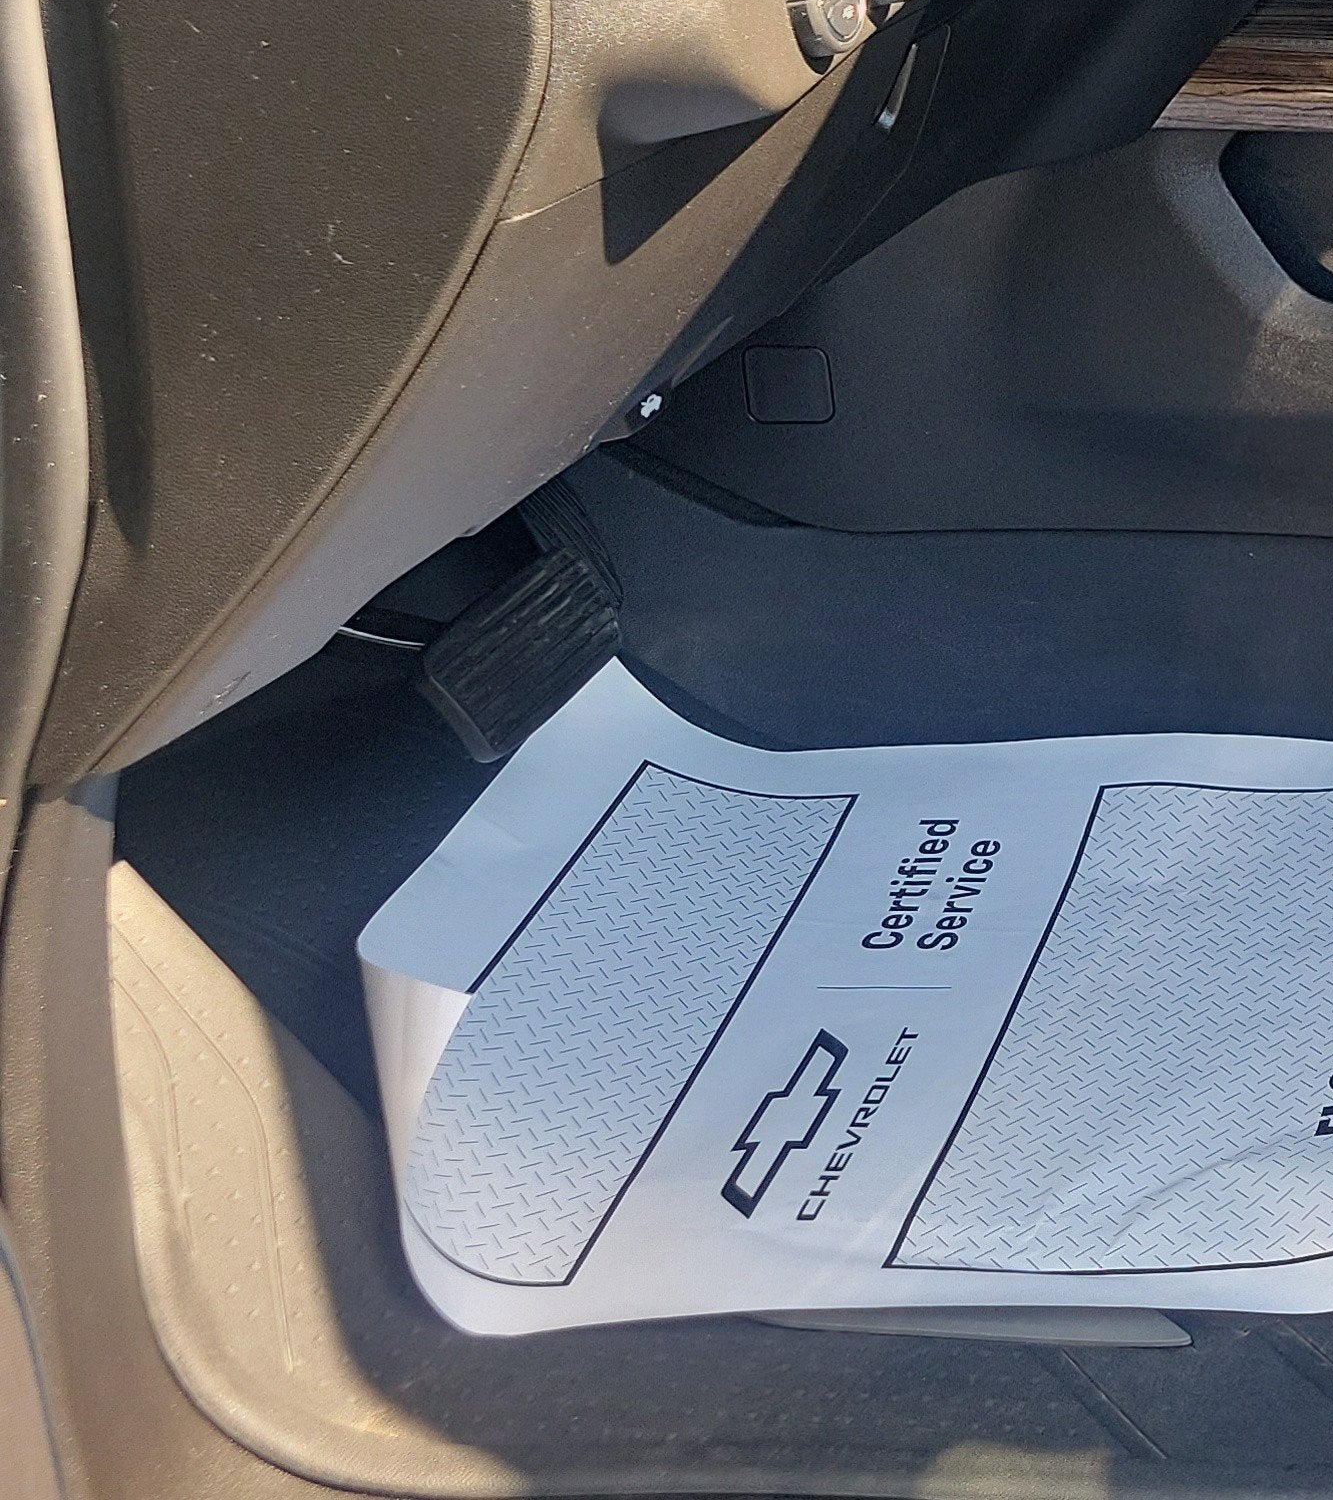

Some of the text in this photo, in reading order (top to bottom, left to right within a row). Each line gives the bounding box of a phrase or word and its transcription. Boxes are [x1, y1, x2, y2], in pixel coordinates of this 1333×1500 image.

[861, 818, 960, 950] Certified
[916, 839, 1001, 951] Service
[796, 1027, 919, 1221] CHEVROLET
